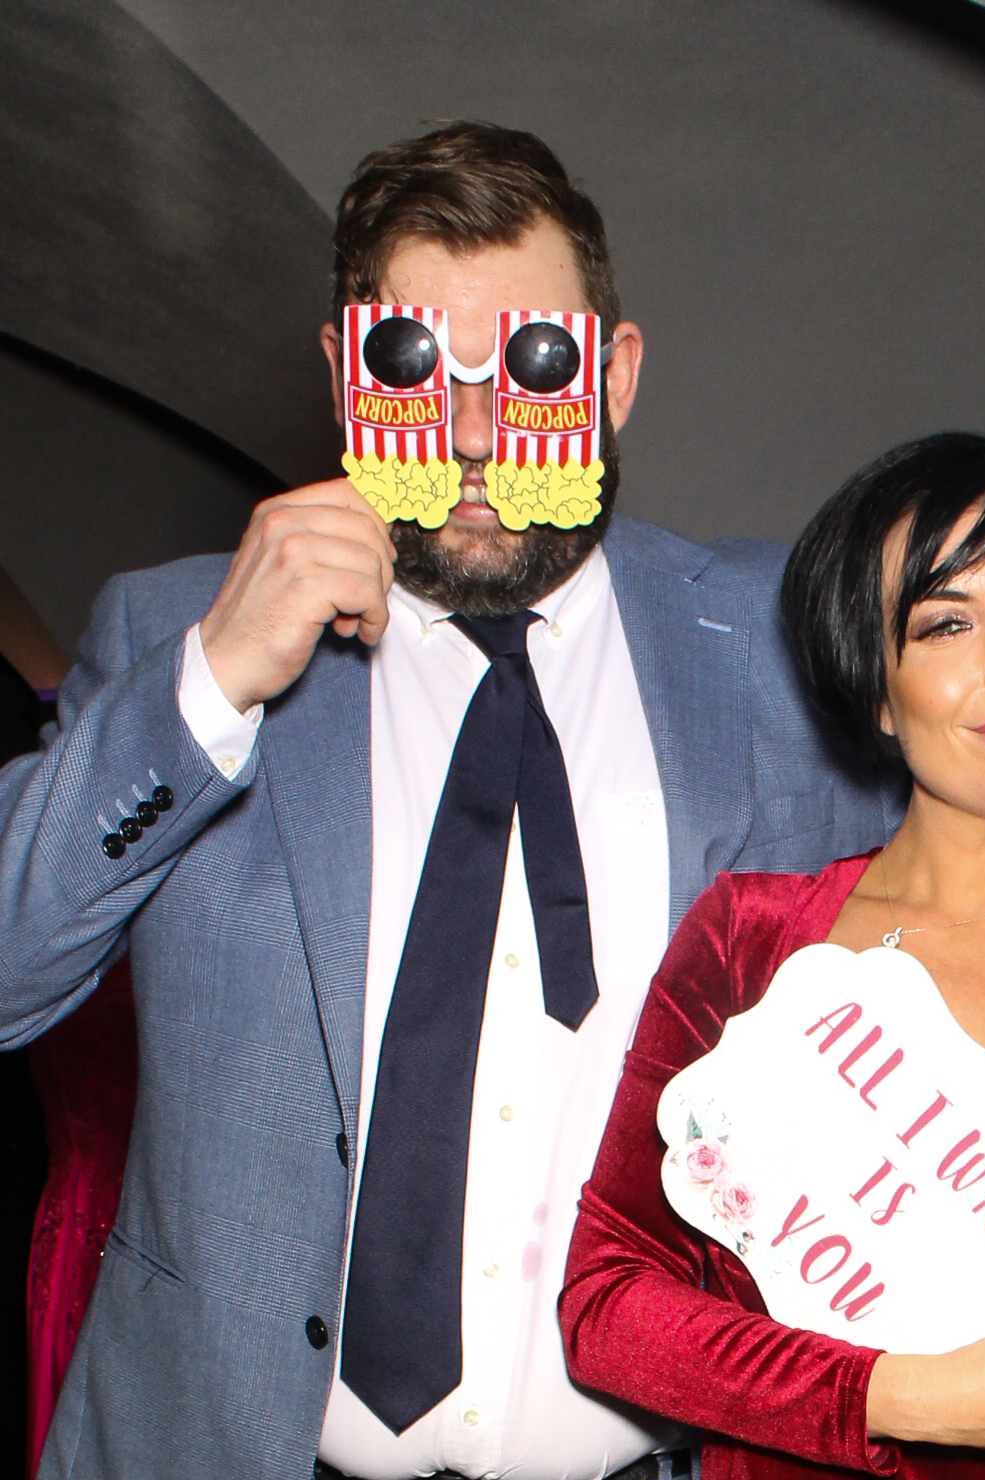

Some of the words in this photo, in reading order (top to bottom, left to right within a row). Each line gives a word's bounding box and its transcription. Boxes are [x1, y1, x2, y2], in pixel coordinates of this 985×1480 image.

[356, 393, 439, 425] POPCORN
[504, 399, 588, 430] POPCORN
[804, 1002, 904, 1111] ALL
[895, 1089, 954, 1150] I
[848, 1156, 916, 1226] IS
[770, 1194, 886, 1322] YOU
